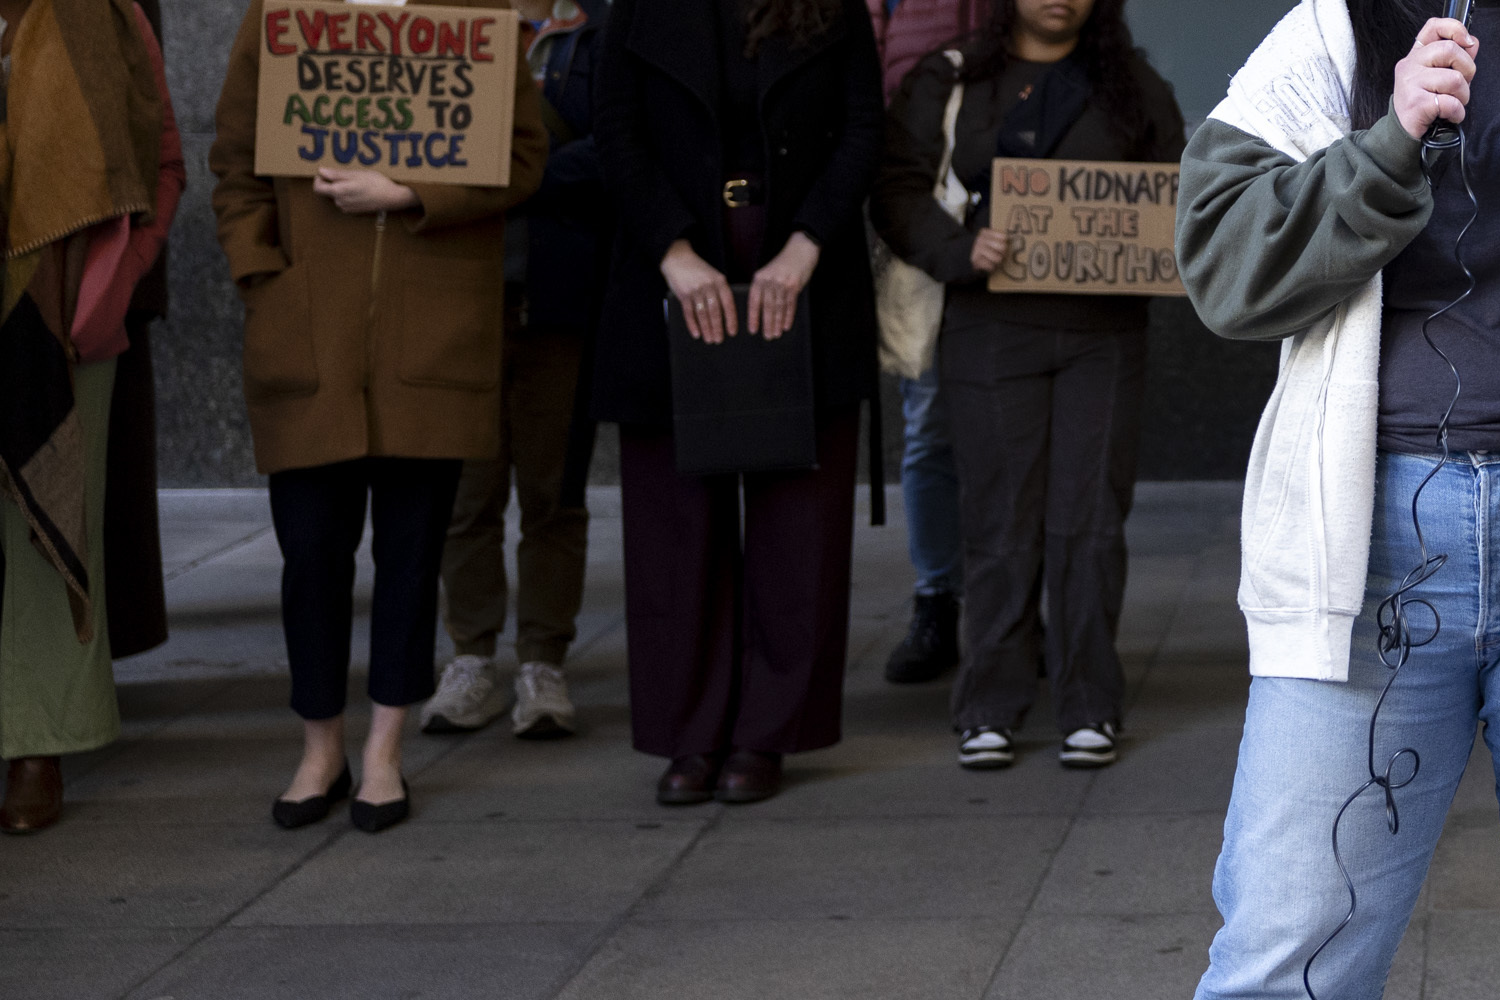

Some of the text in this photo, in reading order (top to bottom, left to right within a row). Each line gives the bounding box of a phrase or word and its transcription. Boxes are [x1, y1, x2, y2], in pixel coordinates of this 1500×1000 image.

[265, 8, 496, 63] EVERYONE
[297, 55, 475, 99] DESERVES
[283, 92, 473, 131] ACCESS TO
[298, 125, 468, 168] JUSTICE
[1002, 165, 1050, 197] NO
[1007, 203, 1140, 239] AT THE
